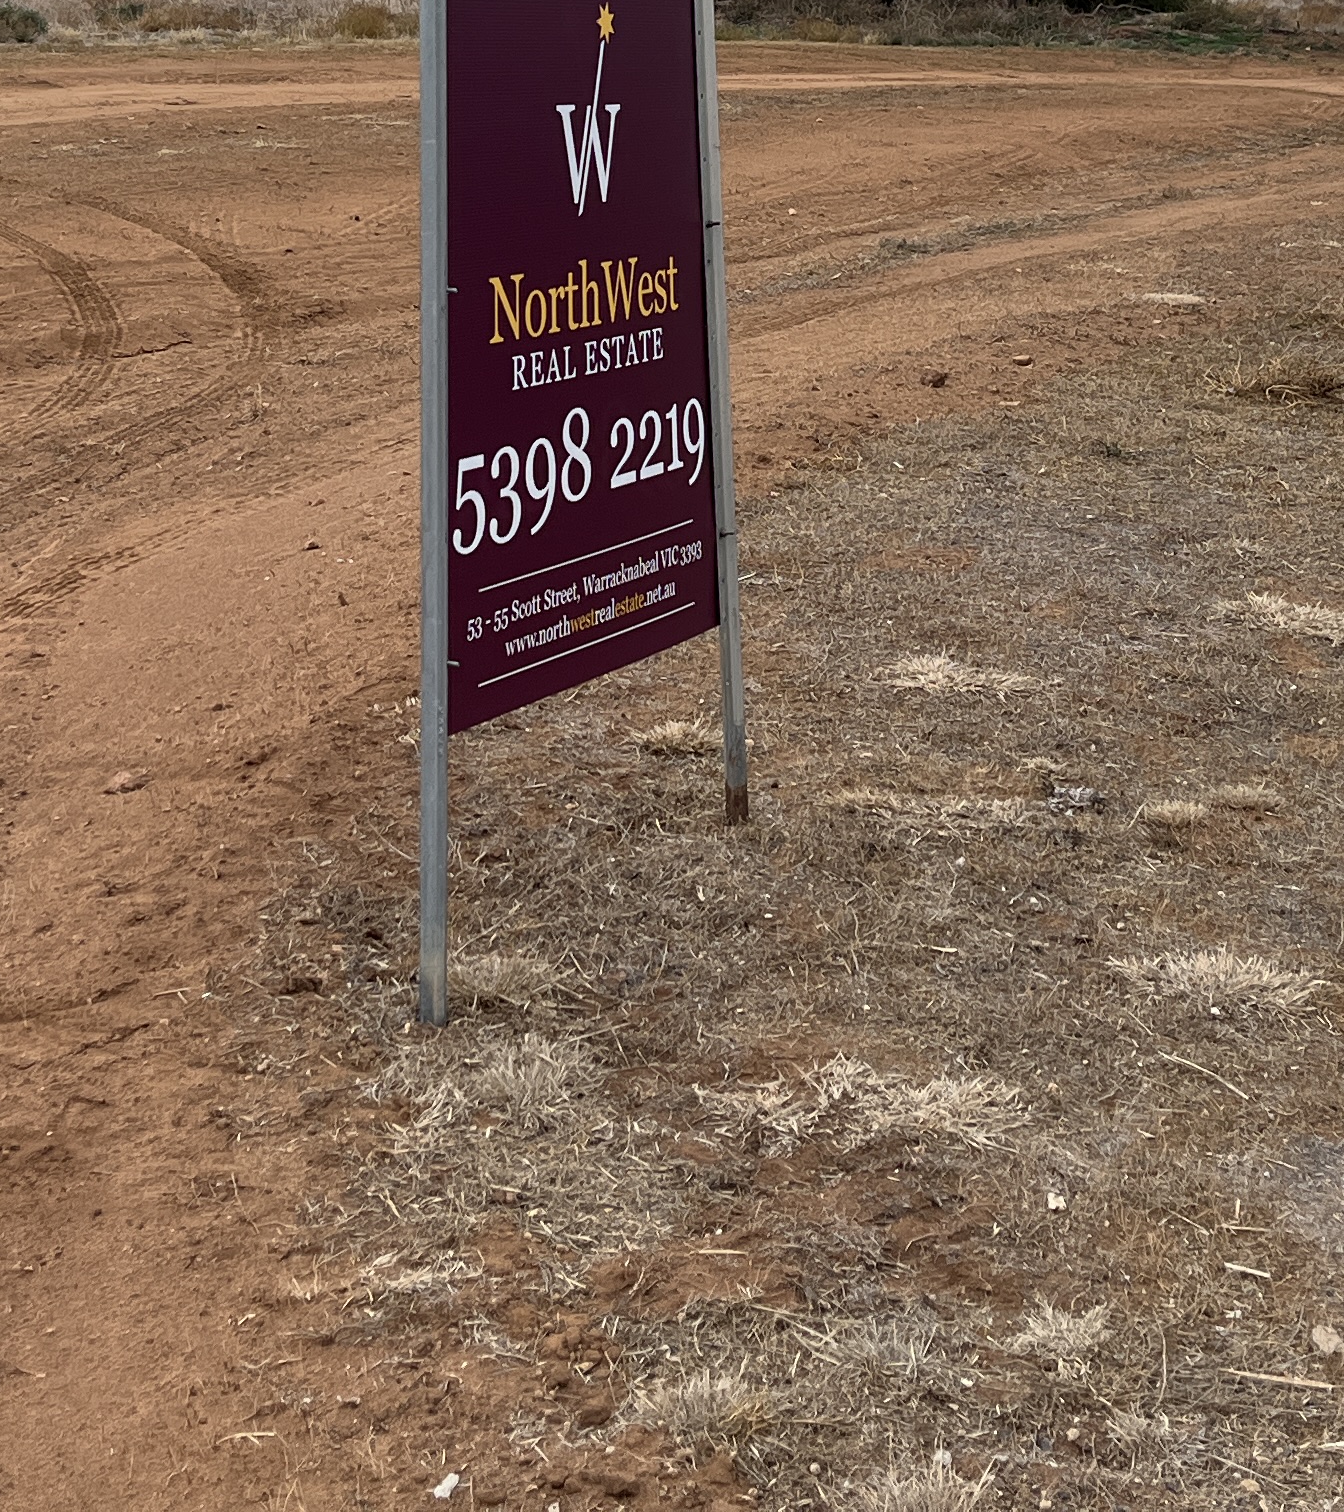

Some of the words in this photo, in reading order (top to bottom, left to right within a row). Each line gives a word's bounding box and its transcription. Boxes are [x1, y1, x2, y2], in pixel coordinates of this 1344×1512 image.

[555, 103, 621, 217] W
[488, 256, 679, 344] NorthWest
[511, 345, 577, 391] REAL
[584, 327, 664, 376] ESTATE
[452, 406, 592, 555] 5398
[610, 397, 705, 489] 2219
[466, 616, 483, 641] 53
[493, 607, 509, 633] 55
[511, 596, 542, 623] Scott
[543, 581, 581, 611] Street,
[582, 551, 659, 597] Warracknabeal
[660, 545, 679, 569] VIC
[679, 540, 703, 567] 3393
[505, 581, 676, 656] www.northwestrealestate.net.au
